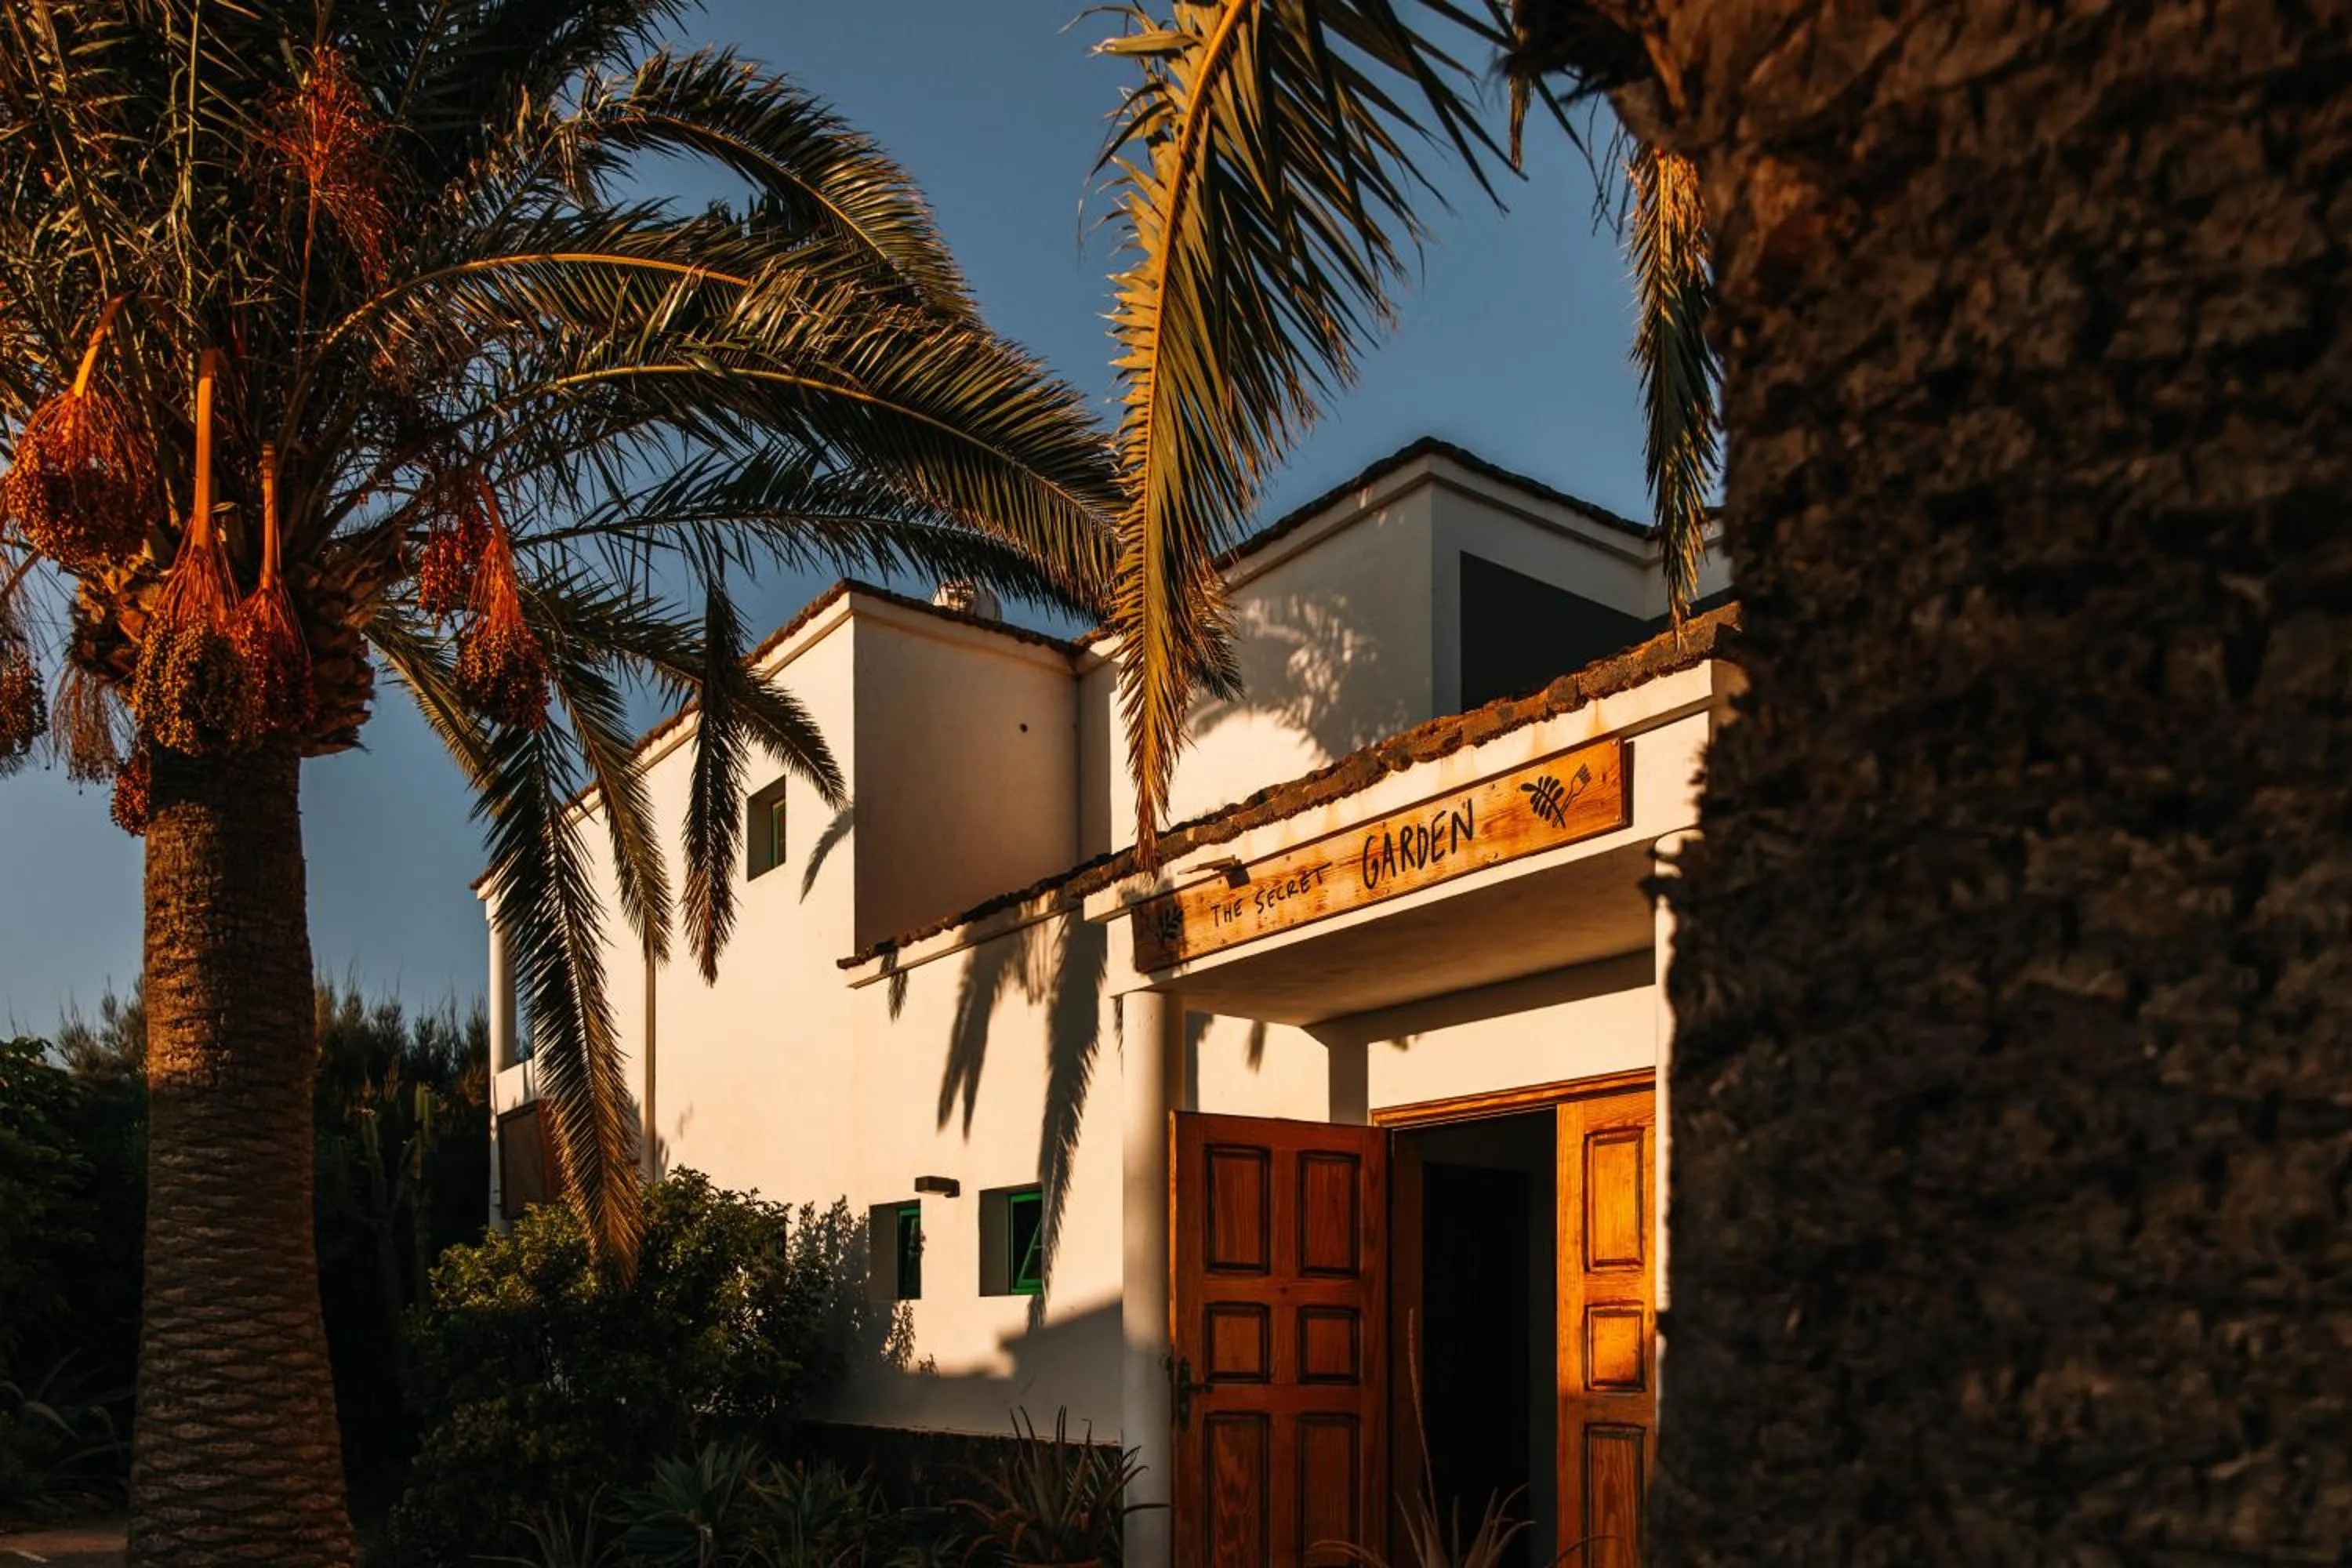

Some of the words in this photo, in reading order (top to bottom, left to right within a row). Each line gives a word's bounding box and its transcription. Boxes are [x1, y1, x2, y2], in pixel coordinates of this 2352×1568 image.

[1210, 898, 1243, 927] THE
[1254, 862, 1332, 914] SECRET
[1363, 798, 1473, 890] GARDEN
